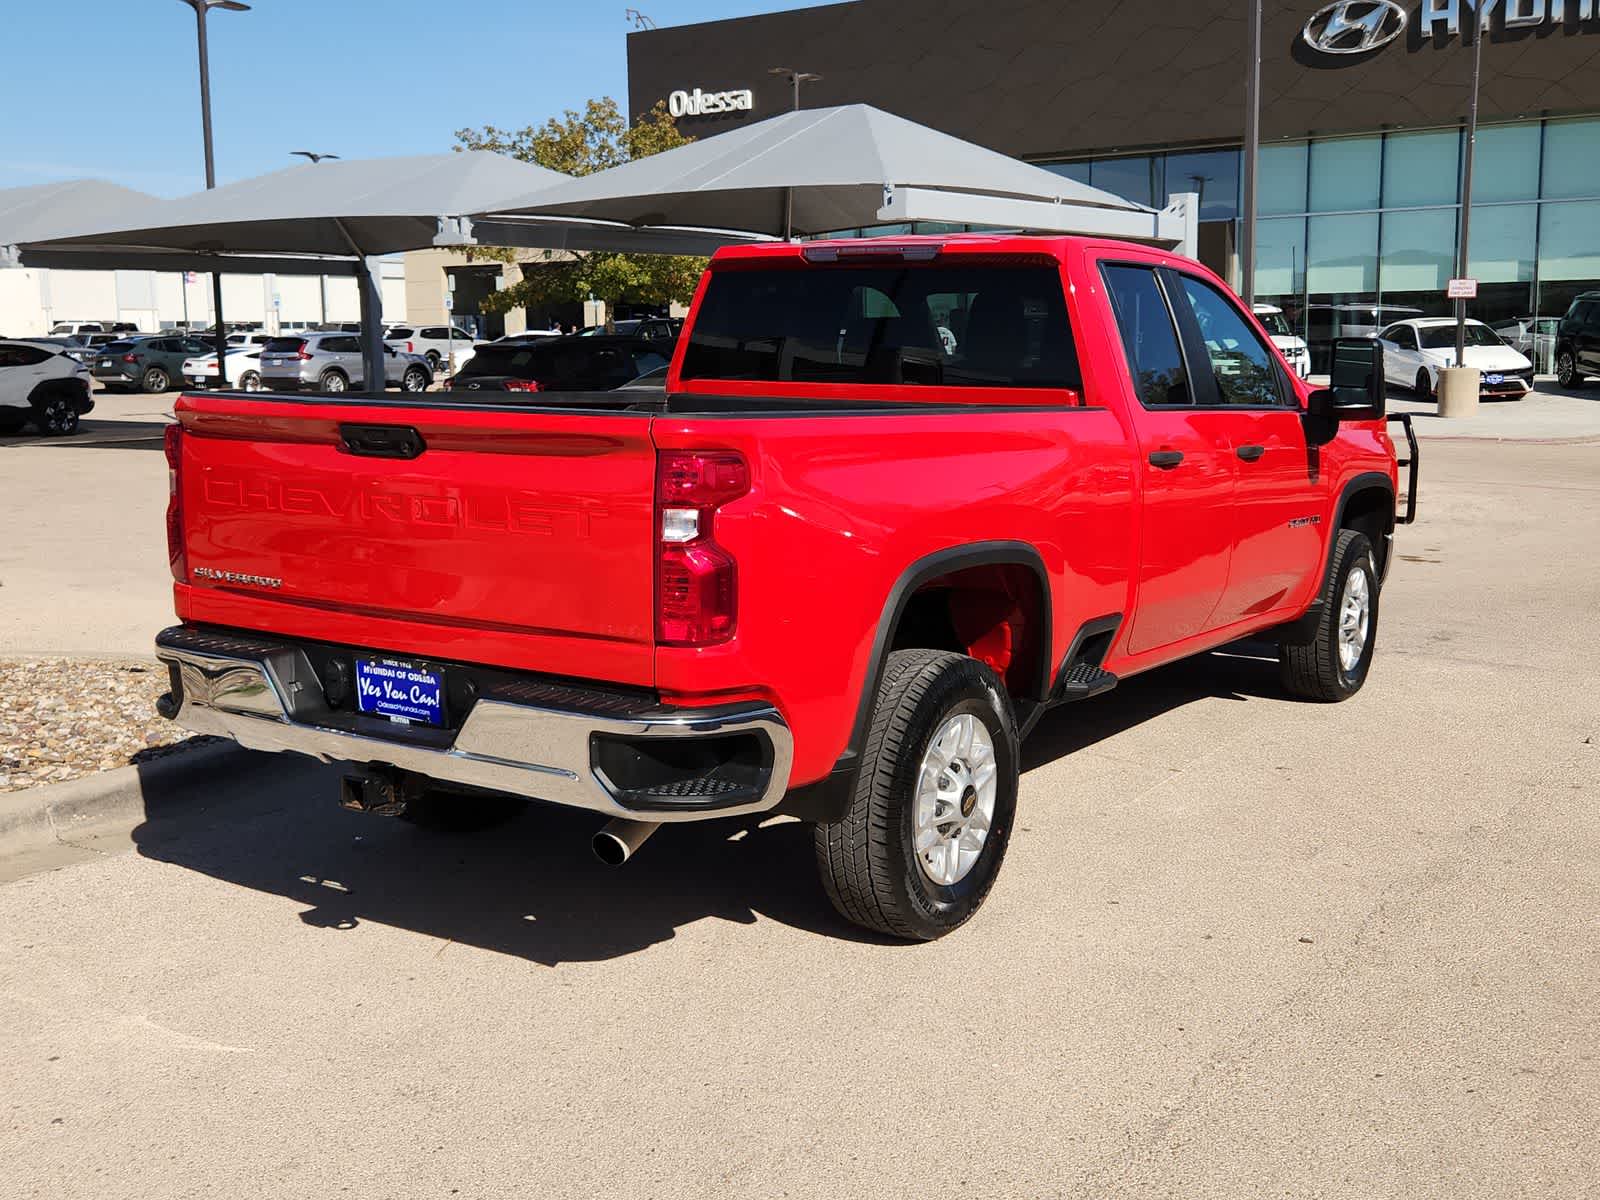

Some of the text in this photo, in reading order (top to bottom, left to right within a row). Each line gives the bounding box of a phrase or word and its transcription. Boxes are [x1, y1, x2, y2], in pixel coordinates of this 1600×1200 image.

[669, 88, 752, 117] Odessa
[203, 478, 609, 538] CHEVROLET
[363, 665, 436, 685] HYUNDAI OF ODESSA
[361, 677, 440, 708] Yes You Can!
